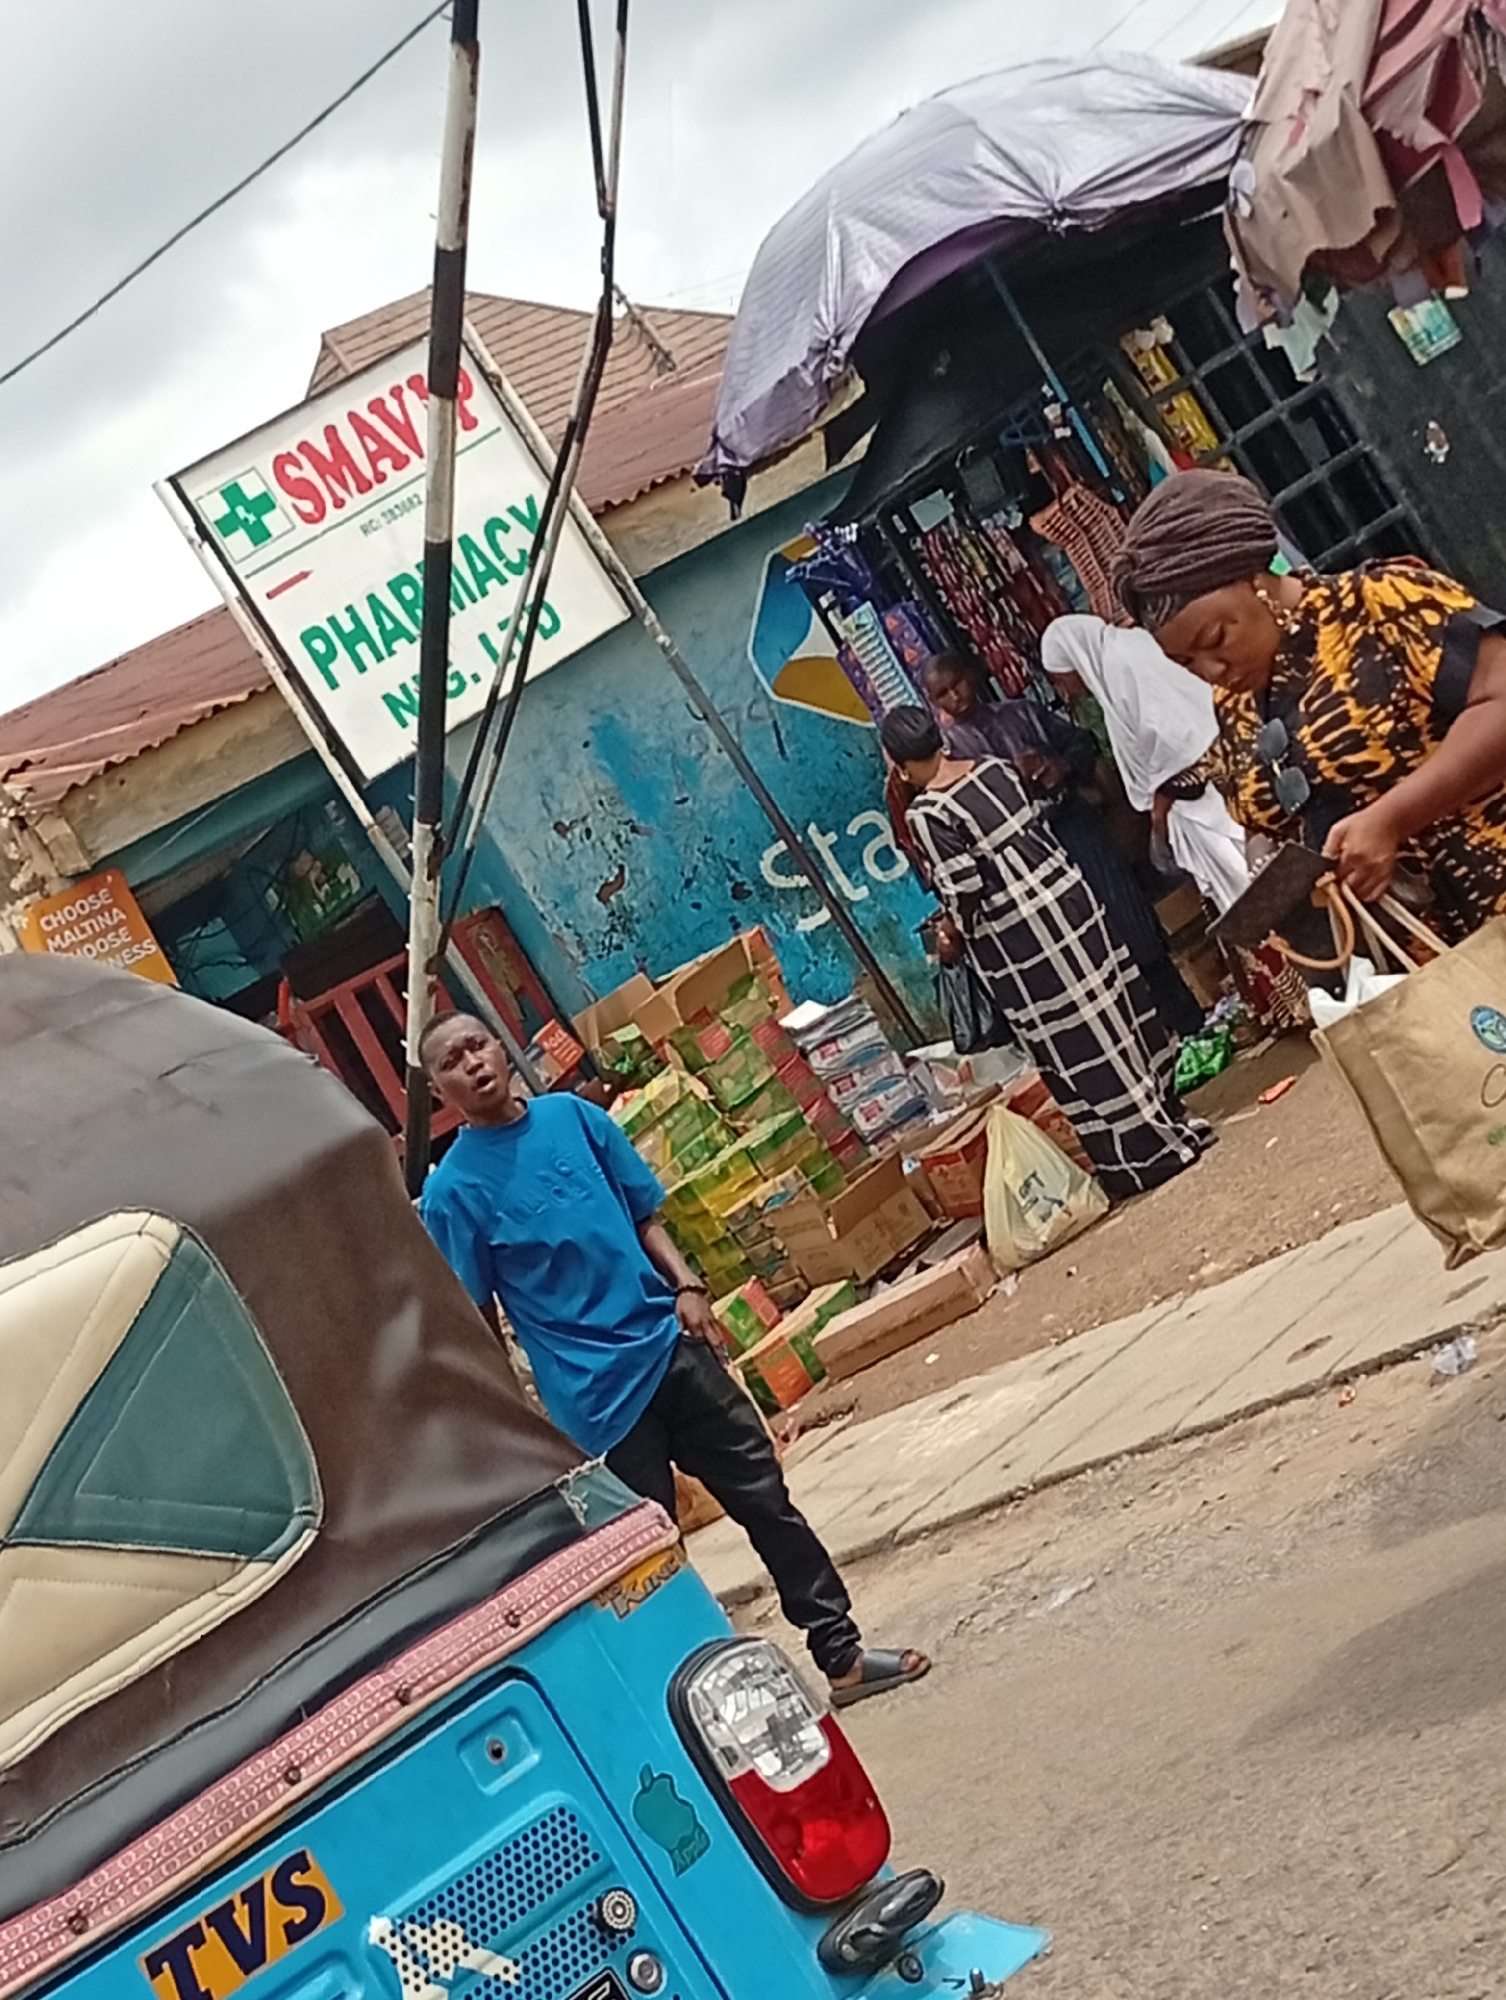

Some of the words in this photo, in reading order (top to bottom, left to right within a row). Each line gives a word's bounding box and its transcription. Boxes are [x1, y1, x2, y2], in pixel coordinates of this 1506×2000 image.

[272, 366, 478, 525] SMAVP
[40, 888, 113, 931] CHOOSE
[46, 907, 127, 955] MALTINA
[72, 926, 132, 960] OOSE
[143, 1849, 327, 2000] TVS
